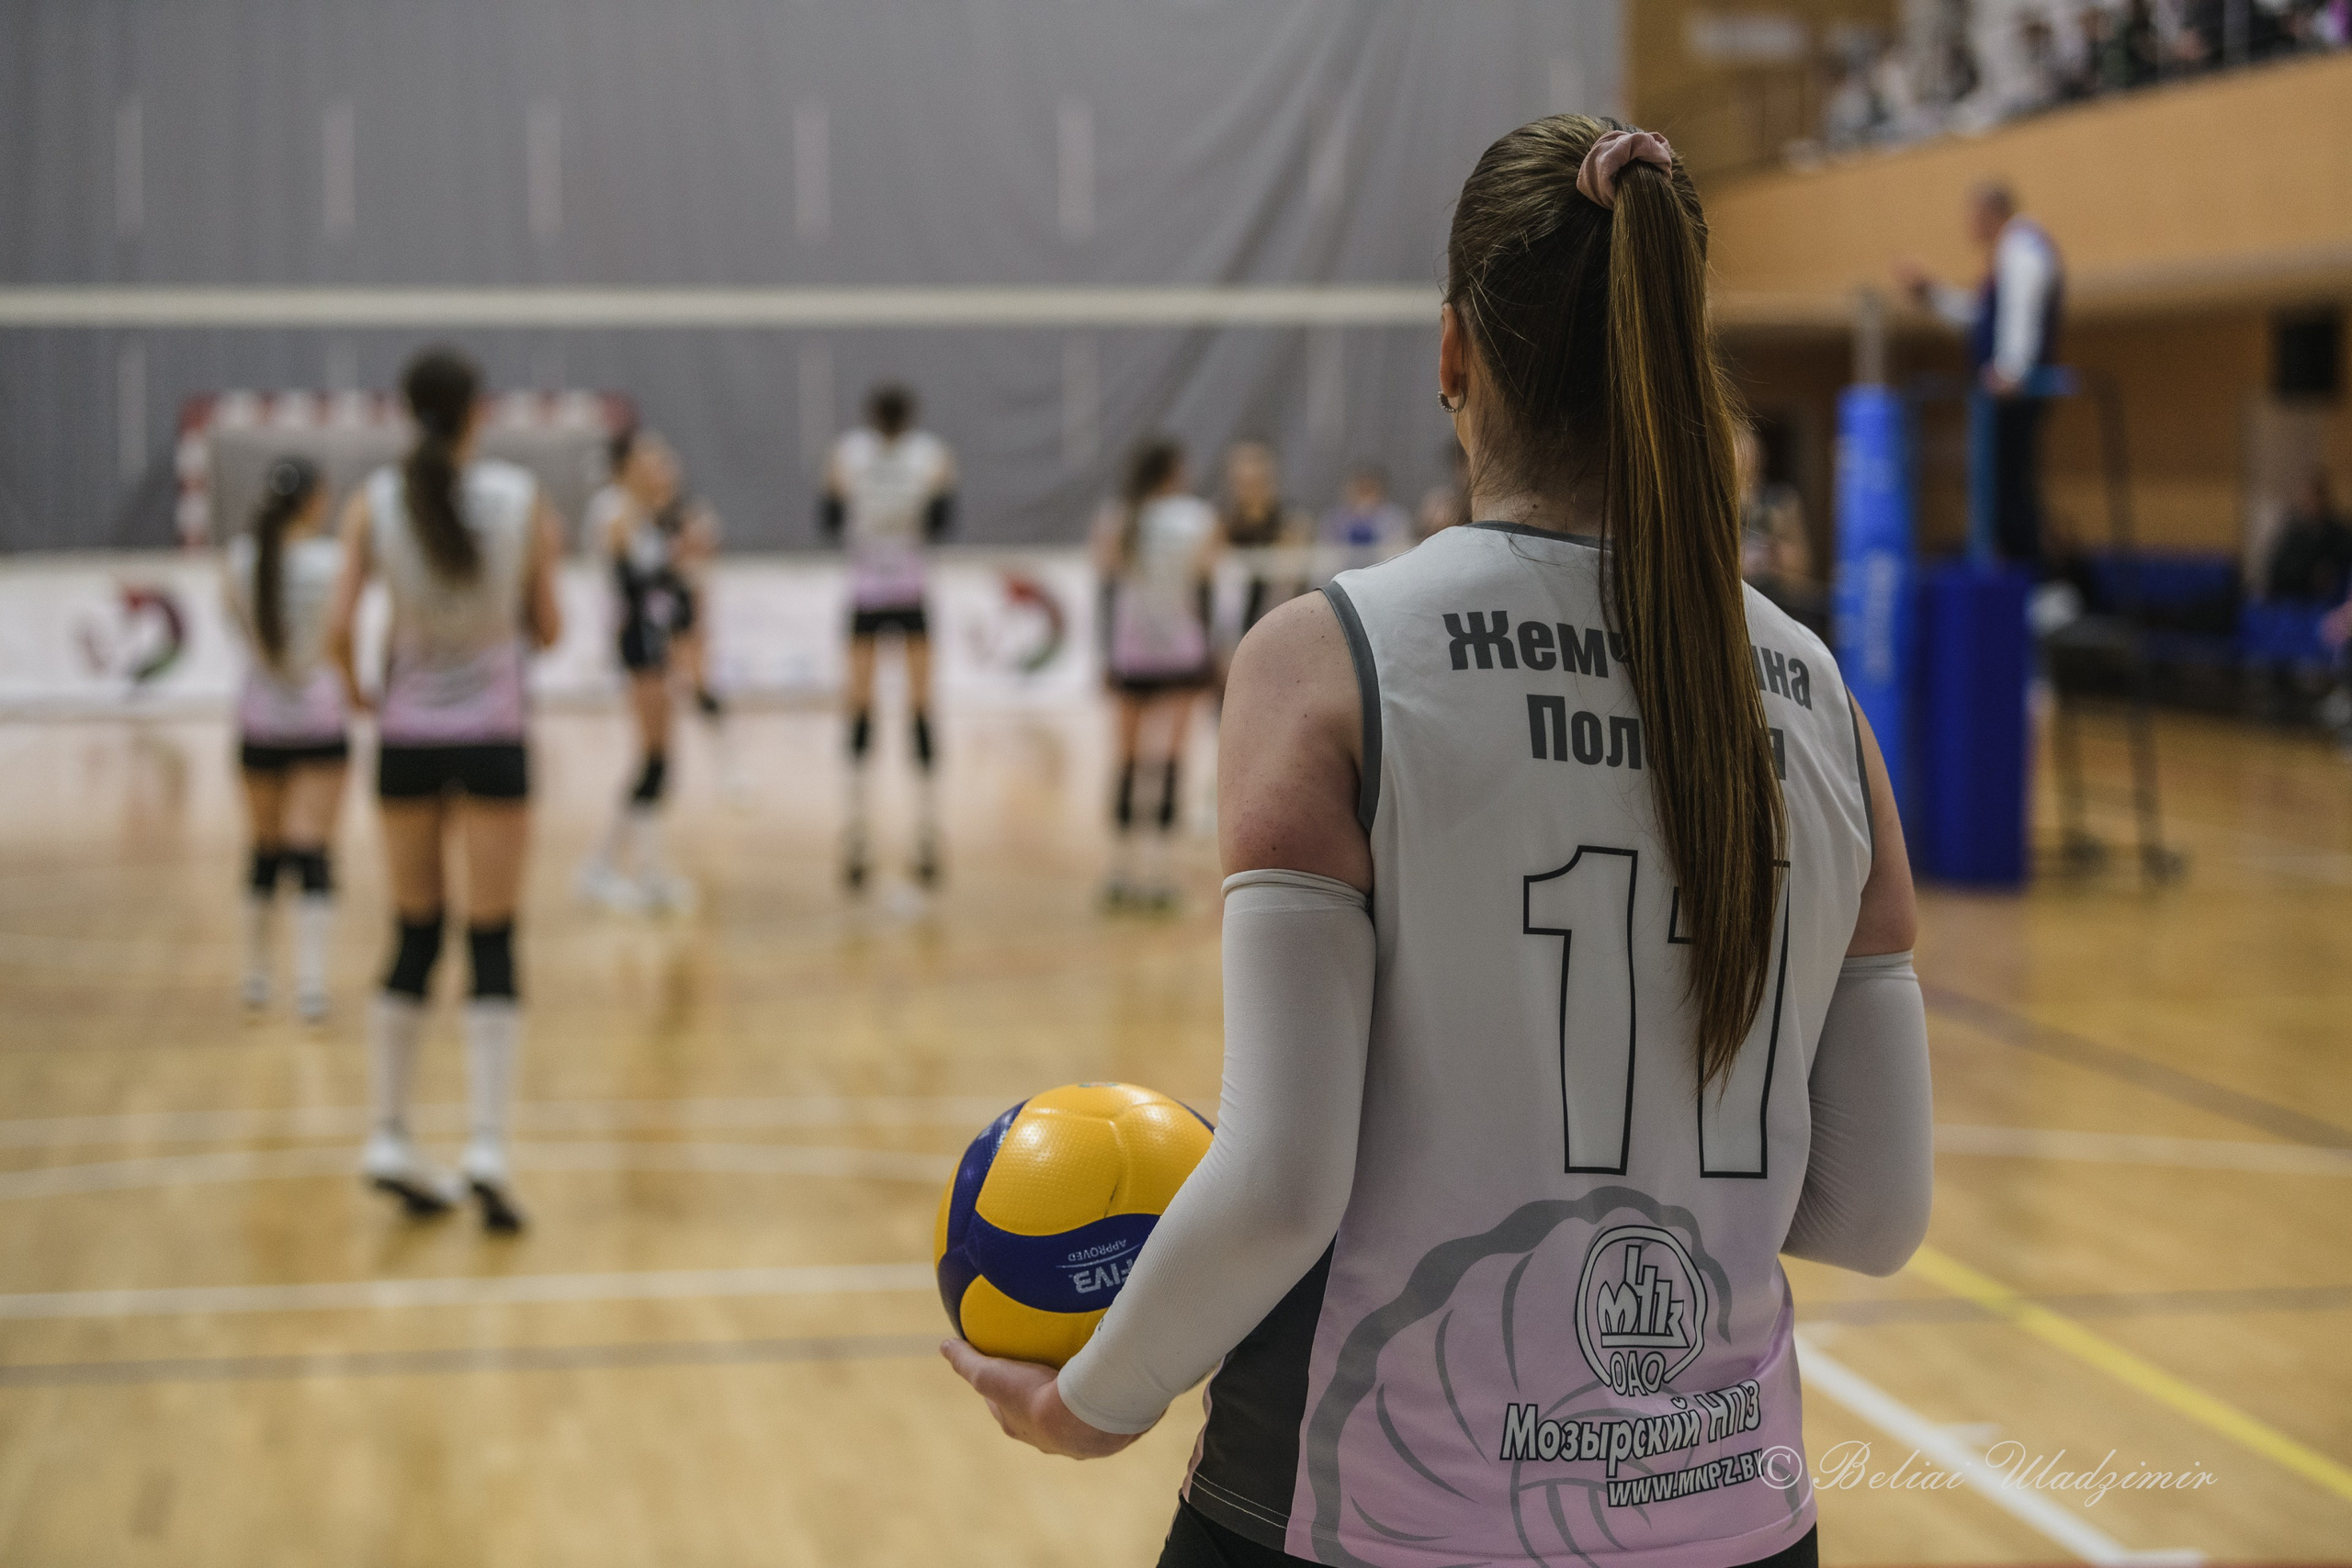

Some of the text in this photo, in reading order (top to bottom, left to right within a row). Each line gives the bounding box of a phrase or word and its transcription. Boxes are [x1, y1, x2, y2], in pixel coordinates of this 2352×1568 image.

[1442, 610, 1813, 711] Жемна
[1068, 1239, 1126, 1262] APPROVED
[1610, 1350, 1666, 1397] ОАО
[1499, 1379, 1761, 1478] Мозырский НПЗ
